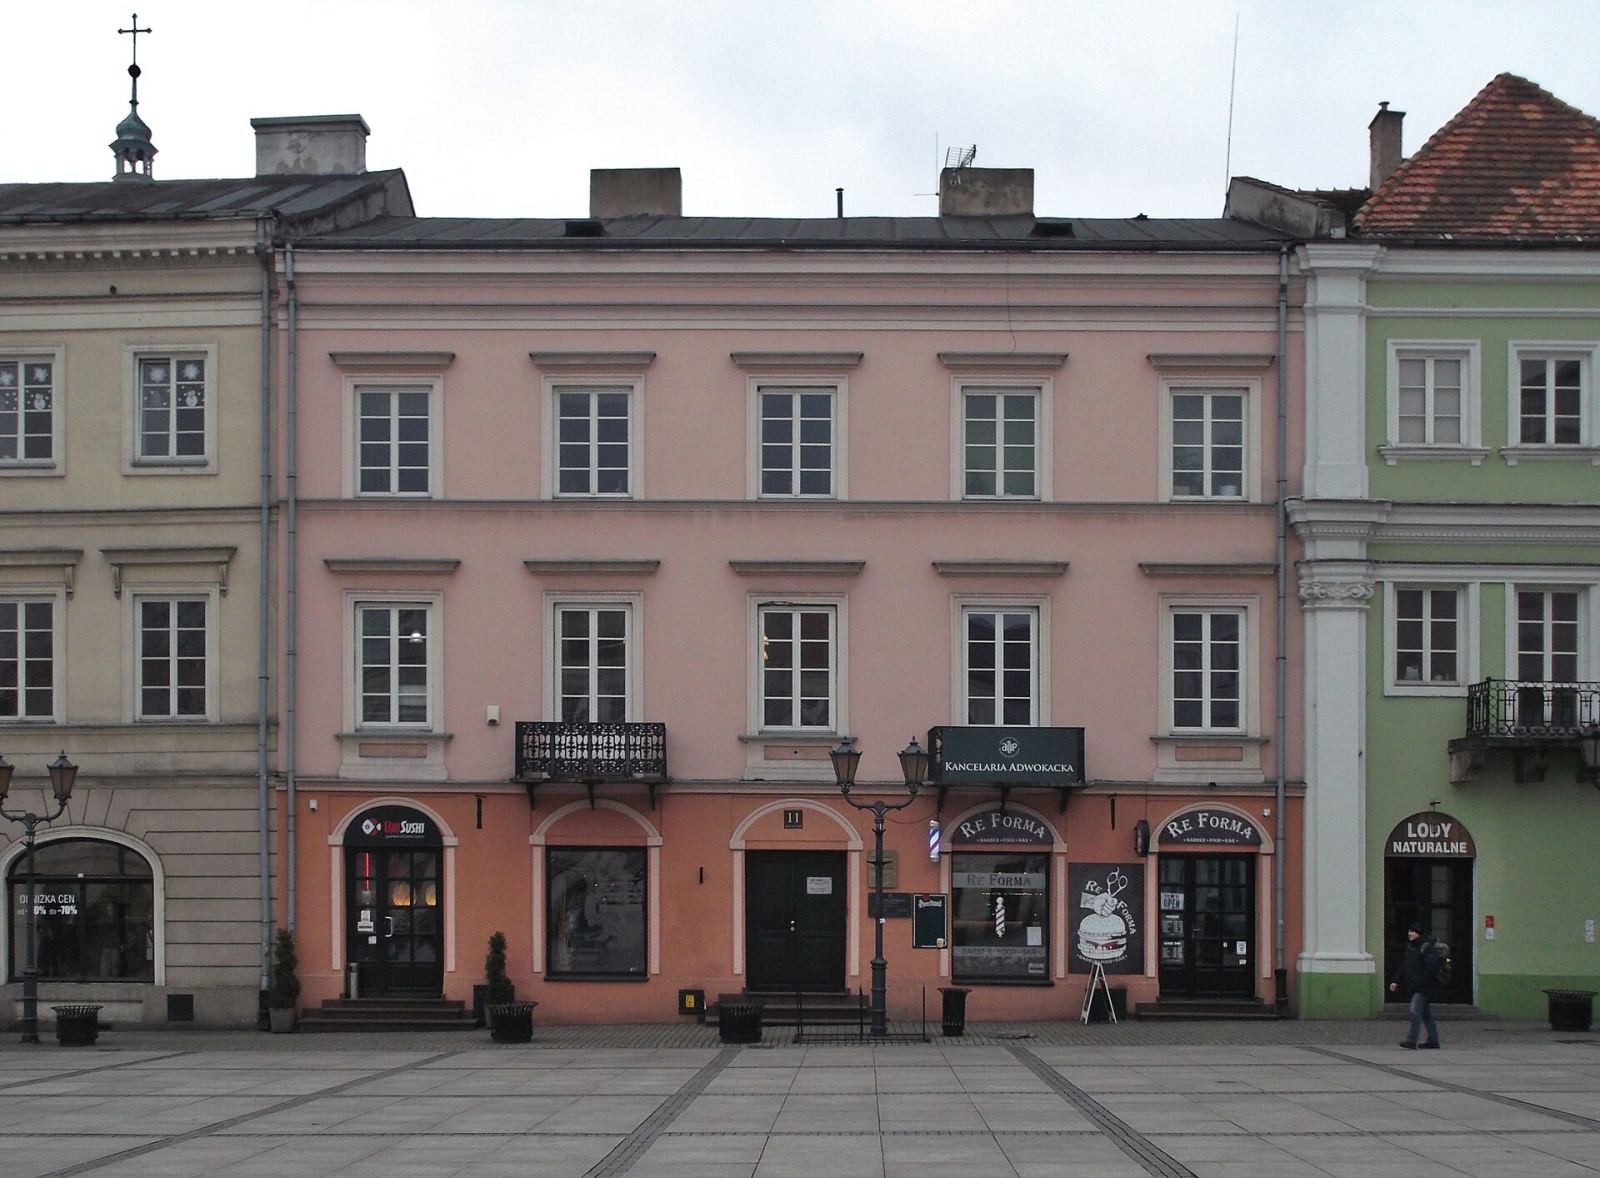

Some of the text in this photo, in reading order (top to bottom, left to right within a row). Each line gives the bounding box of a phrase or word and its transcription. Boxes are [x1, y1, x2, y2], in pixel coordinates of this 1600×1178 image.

[945, 761, 1075, 773] KANCELARIA ADWOKACKA
[788, 812, 799, 823] 11
[400, 820, 425, 834] SUSHI
[960, 812, 1046, 839] RE FORMA
[1166, 812, 1253, 840] RE FORMA
[1407, 822, 1452, 838] LODY
[1393, 841, 1467, 854] NATURALNE
[967, 873, 1032, 887] RE FORMA
[1085, 880, 1103, 894] RE
[58, 894, 75, 904] CEN
[57, 904, 78, 915] -70%
[1116, 900, 1137, 935] FORMA
